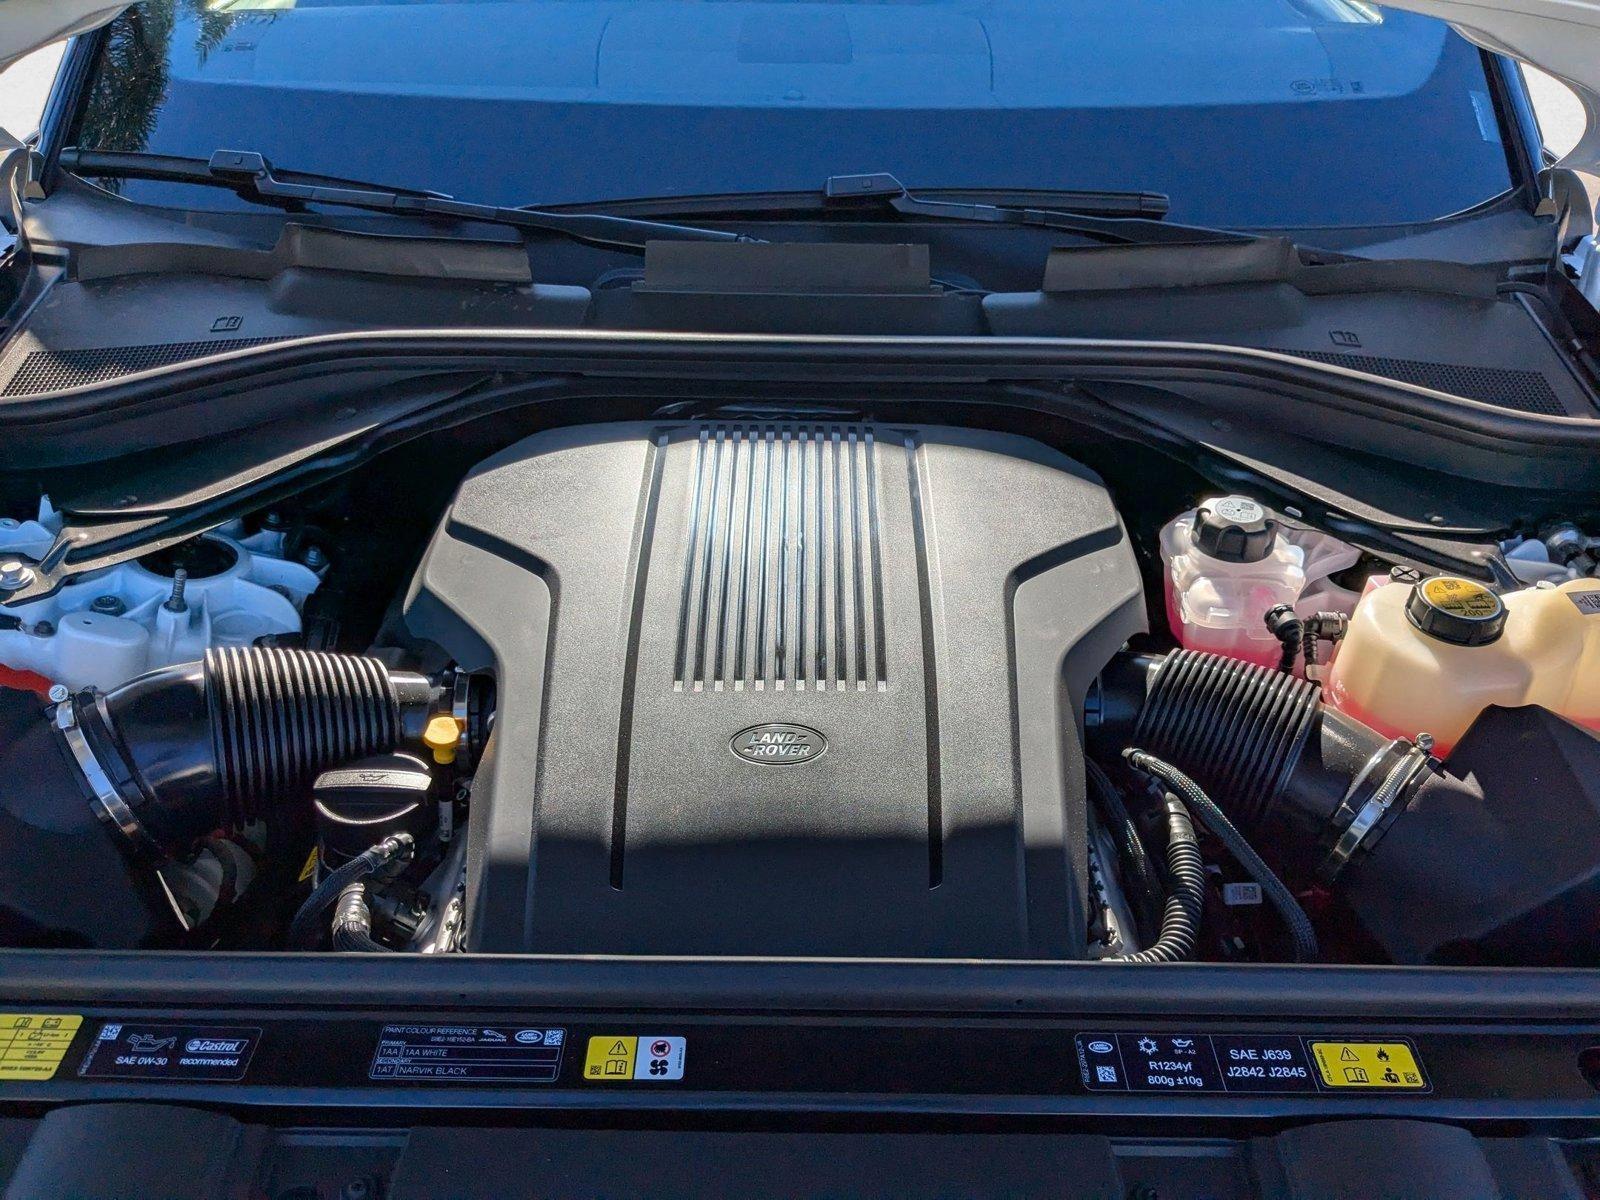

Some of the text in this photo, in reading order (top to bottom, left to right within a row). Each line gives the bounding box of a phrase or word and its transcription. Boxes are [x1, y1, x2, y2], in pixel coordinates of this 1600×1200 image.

[749, 732, 797, 744] LAND
[753, 744, 811, 756] ROVER
[437, 1027, 478, 1035] REFERENCE
[200, 1040, 240, 1052] Castrol
[405, 1048, 420, 1056] 1AA
[422, 1049, 448, 1057] WHITE
[1229, 1049, 1292, 1060] SAE J639
[115, 1056, 168, 1066] SAE 0W-30
[179, 1058, 239, 1066] recommended
[1148, 1061, 1193, 1072] R1234yf
[400, 1066, 433, 1074] NARVIK
[435, 1067, 468, 1075] BLACK
[1227, 1066, 1307, 1078] J2842 J2845
[1147, 1075, 1203, 1087] 800g ±10g
